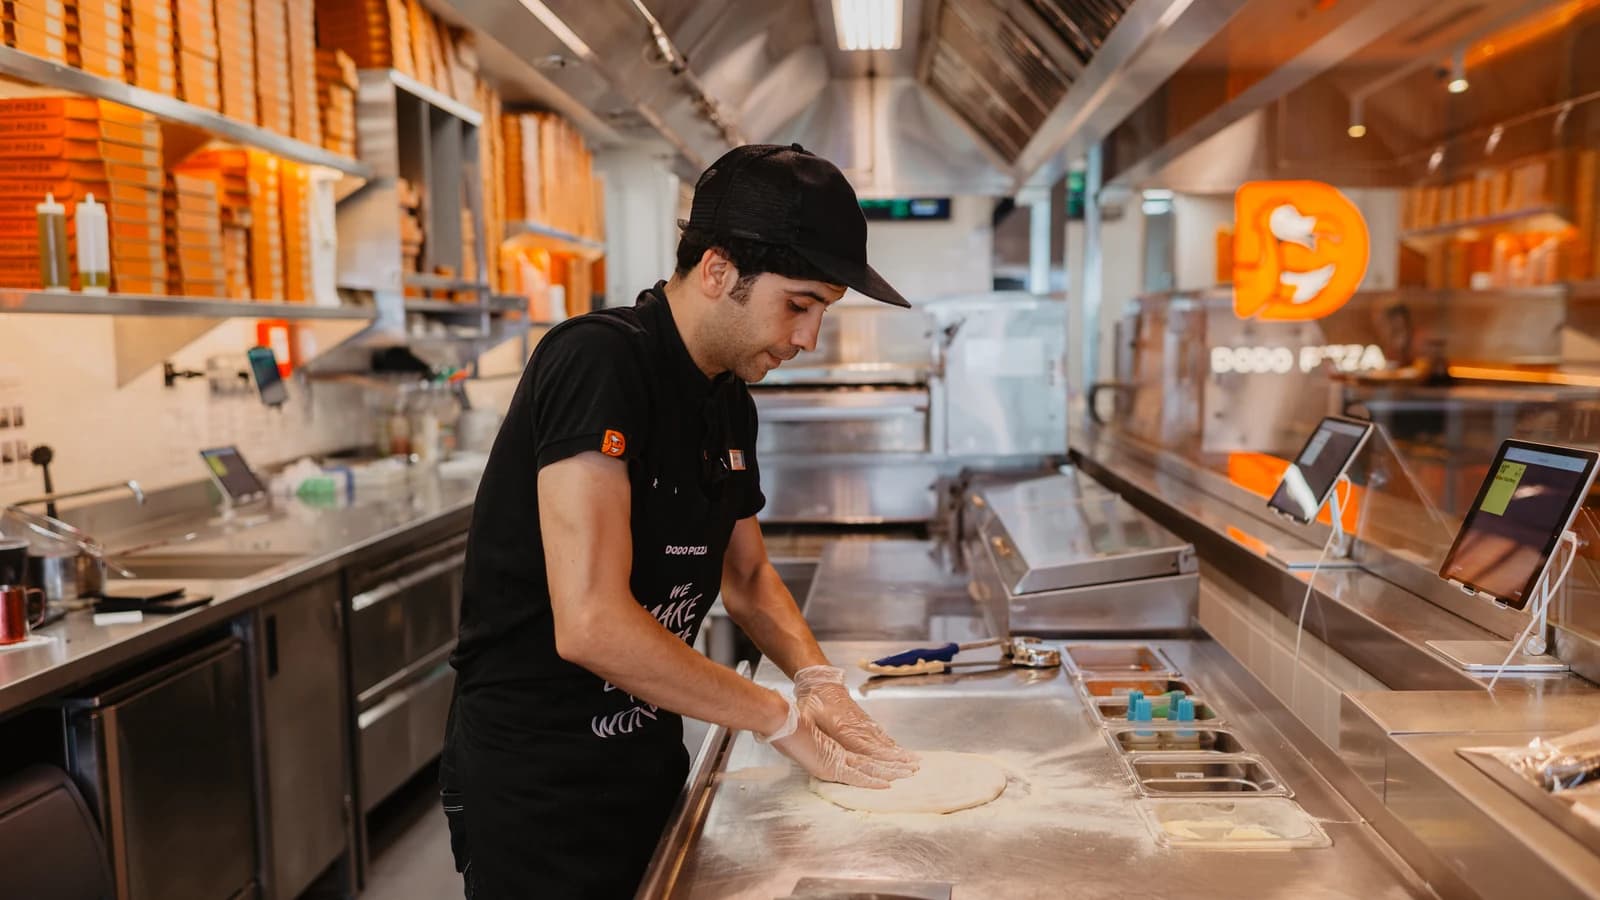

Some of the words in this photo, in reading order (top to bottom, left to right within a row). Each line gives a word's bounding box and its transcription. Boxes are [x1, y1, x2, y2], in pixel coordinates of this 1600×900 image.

[1211, 346, 1293, 374] DODO
[665, 545, 688, 555] DODO
[670, 582, 693, 599] WE
